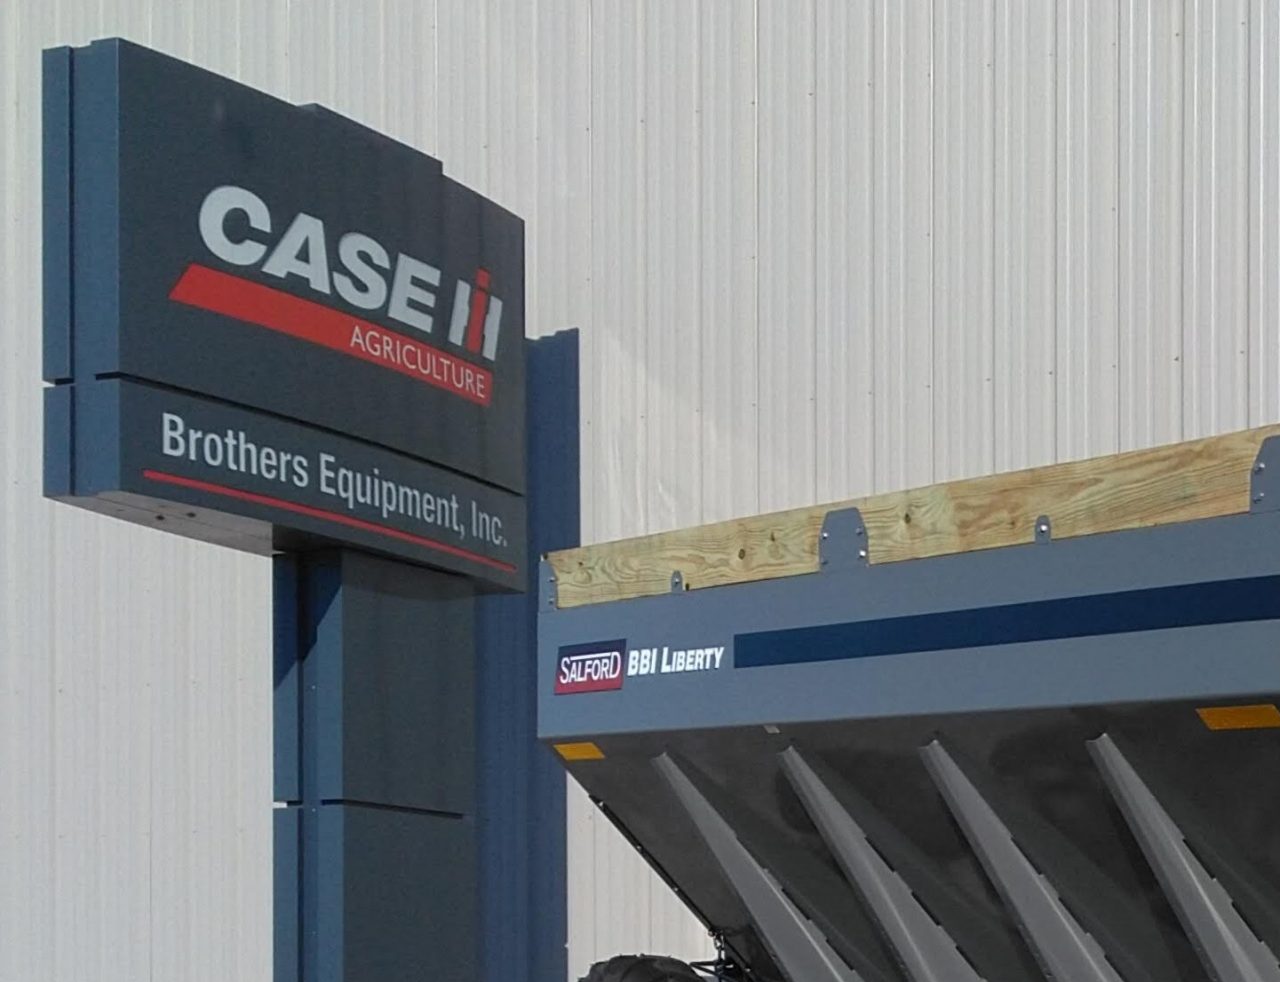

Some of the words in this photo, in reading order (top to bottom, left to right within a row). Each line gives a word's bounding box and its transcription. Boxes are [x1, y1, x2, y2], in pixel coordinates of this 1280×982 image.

[198, 184, 442, 333] CASE
[350, 325, 486, 399] AGRICULTURE
[161, 412, 309, 488] Brothers
[319, 452, 465, 539] Equipment,
[471, 501, 508, 548] Inc.
[559, 651, 621, 684] SALFORD
[627, 648, 658, 676] BBI
[661, 647, 725, 674] LIBERTY
